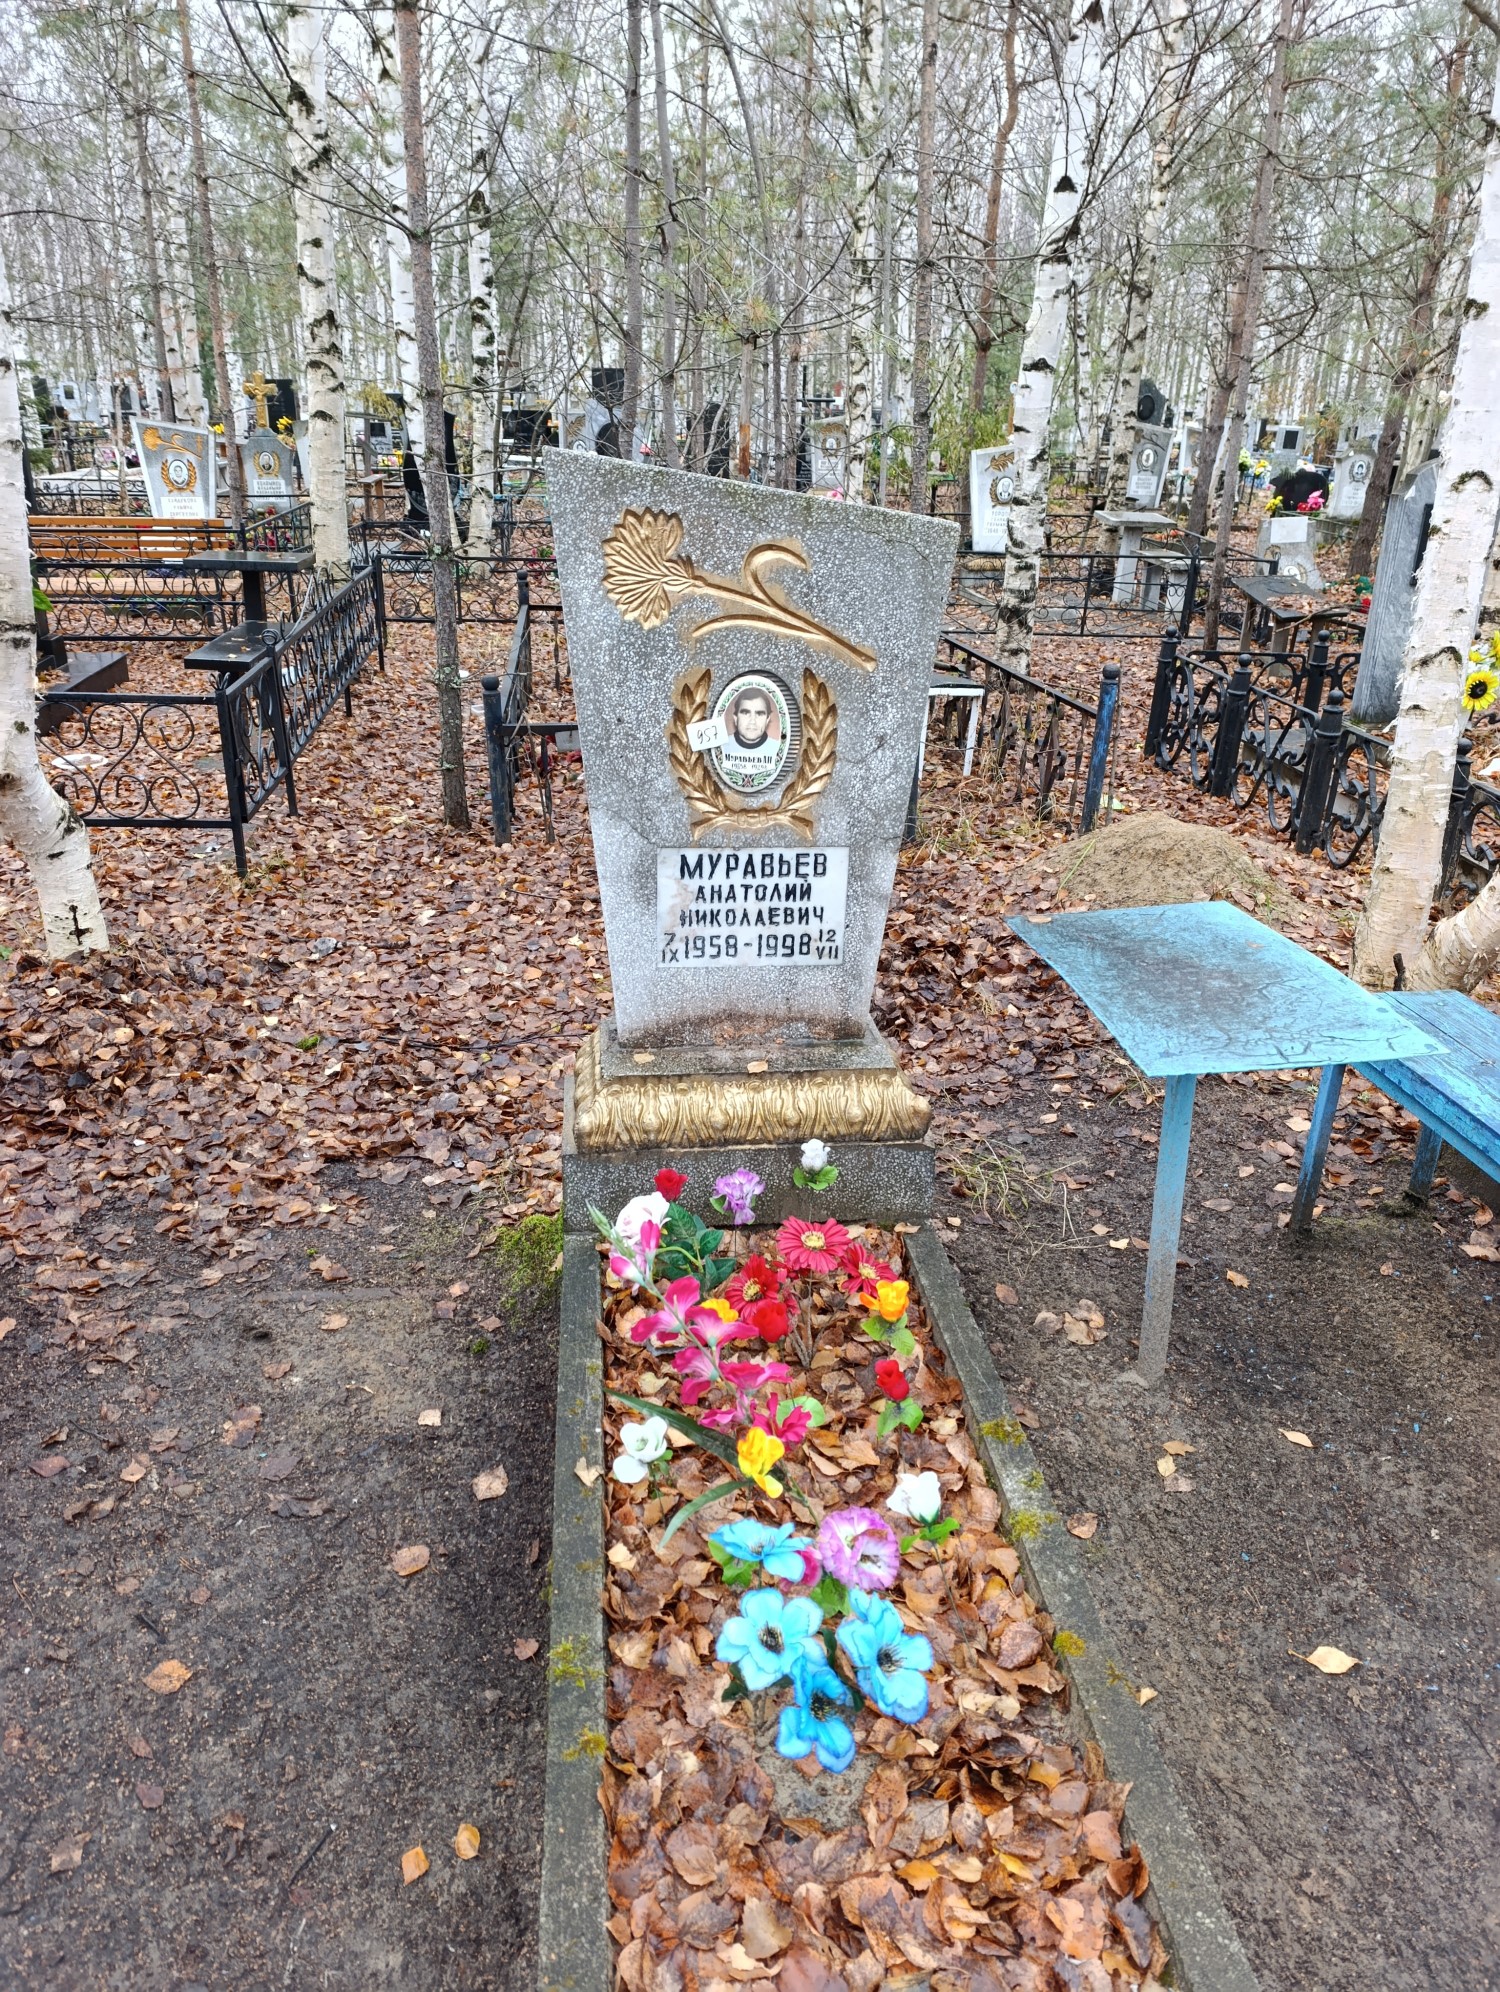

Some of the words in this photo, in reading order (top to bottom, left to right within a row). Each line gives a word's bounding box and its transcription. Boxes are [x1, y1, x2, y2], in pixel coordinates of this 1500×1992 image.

[697, 725, 718, 744] 957
[679, 853, 828, 880] МУРАВЬЕВ
[695, 880, 812, 903] АНАТОЛИЙ
[679, 906, 825, 928] НИКОЛАЕВИЧ
[818, 929, 837, 943] 12
[815, 945, 839, 960] VII
